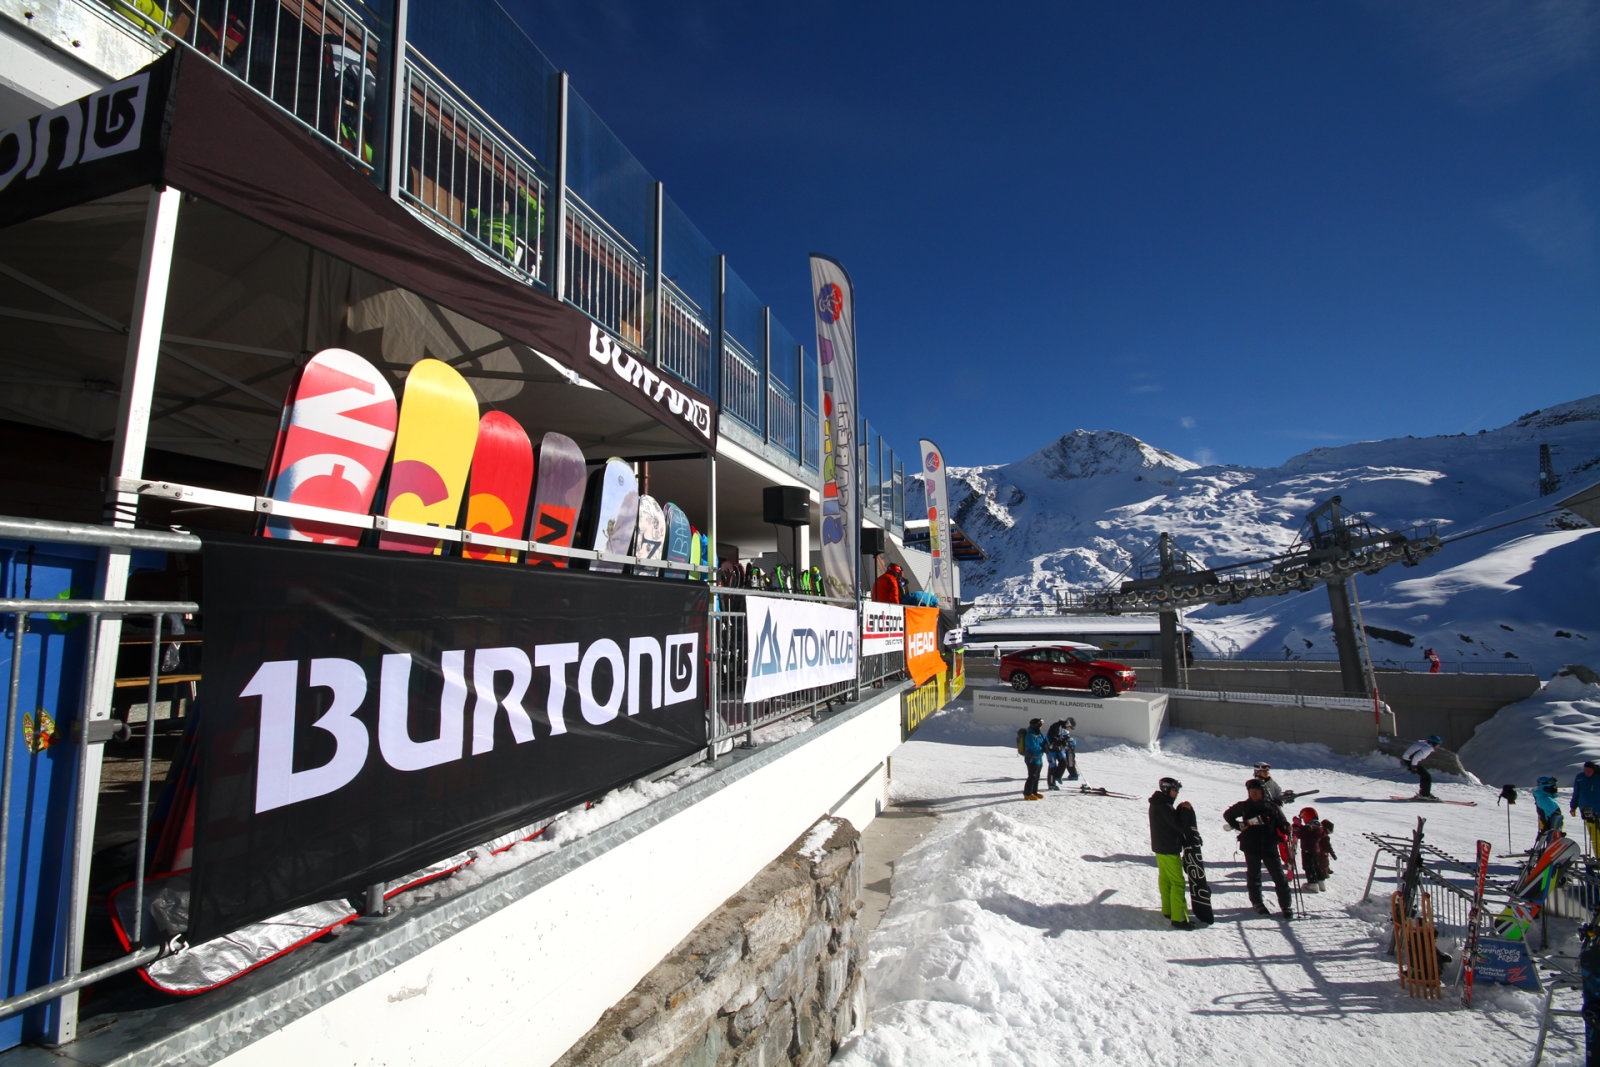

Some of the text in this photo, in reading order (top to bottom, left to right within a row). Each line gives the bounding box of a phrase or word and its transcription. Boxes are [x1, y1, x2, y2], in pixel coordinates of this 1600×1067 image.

[908, 631, 935, 659] HEAD
[238, 635, 663, 814] BURTON
[906, 688, 920, 731] TEST
